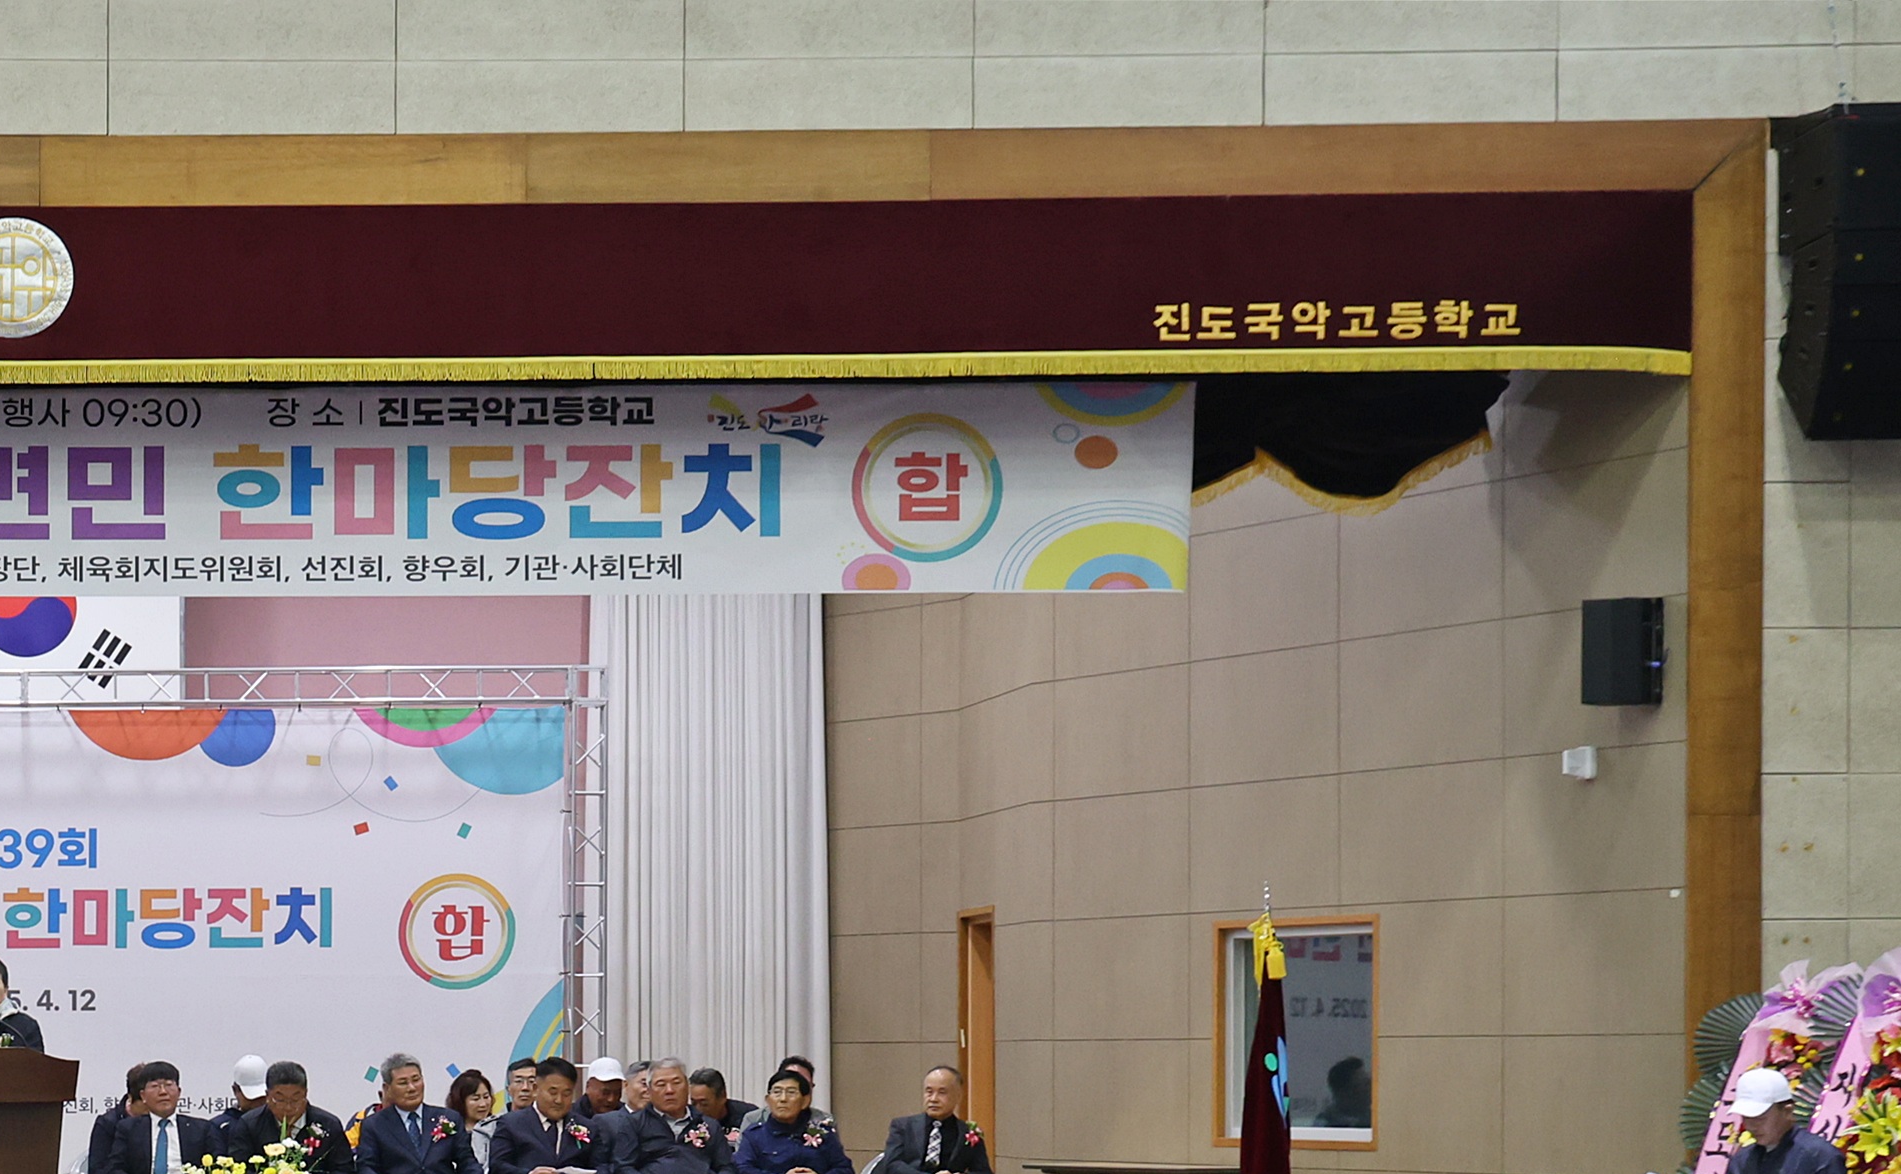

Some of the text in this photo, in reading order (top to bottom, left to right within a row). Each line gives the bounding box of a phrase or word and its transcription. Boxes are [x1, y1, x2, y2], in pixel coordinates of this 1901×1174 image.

[1153, 300, 1521, 341] 진도국악고등학교
[82, 398, 201, 430] 09:30)
[378, 395, 653, 429] 진도국악고등학교
[213, 443, 781, 541] 한마당잔치
[894, 451, 968, 522] 합
[57, 555, 290, 584] 체육회지도위원회,
[301, 555, 392, 584] 선진회,
[403, 555, 494, 584] 향우회,
[505, 554, 683, 582] 기관·사회단체
[3, 887, 332, 949] 한마당잔치
[432, 904, 490, 962] 합
[36, 990, 60, 1012] 4.
[68, 990, 96, 1012] 12
[62, 1097, 98, 1114] 진회,
